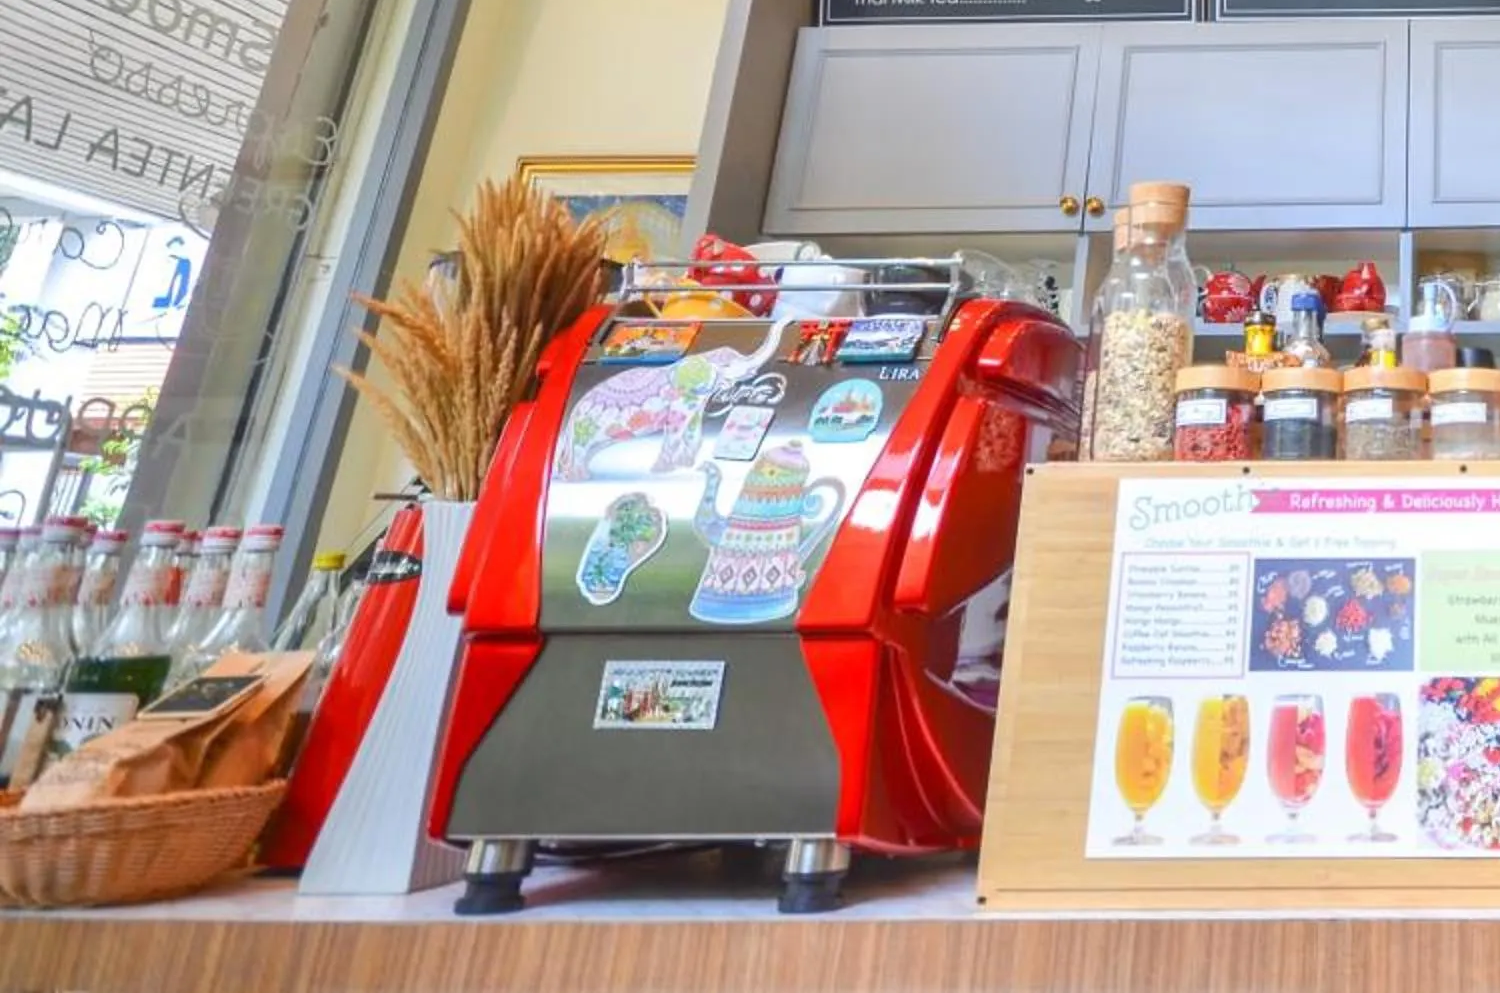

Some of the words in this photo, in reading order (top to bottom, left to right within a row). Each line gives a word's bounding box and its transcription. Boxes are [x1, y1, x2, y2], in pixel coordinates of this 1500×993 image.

[880, 366, 919, 380] LIRA
[1289, 493, 1377, 513] Refreshing
[1383, 494, 1394, 510] &
[1402, 493, 1485, 511] Deliciously
